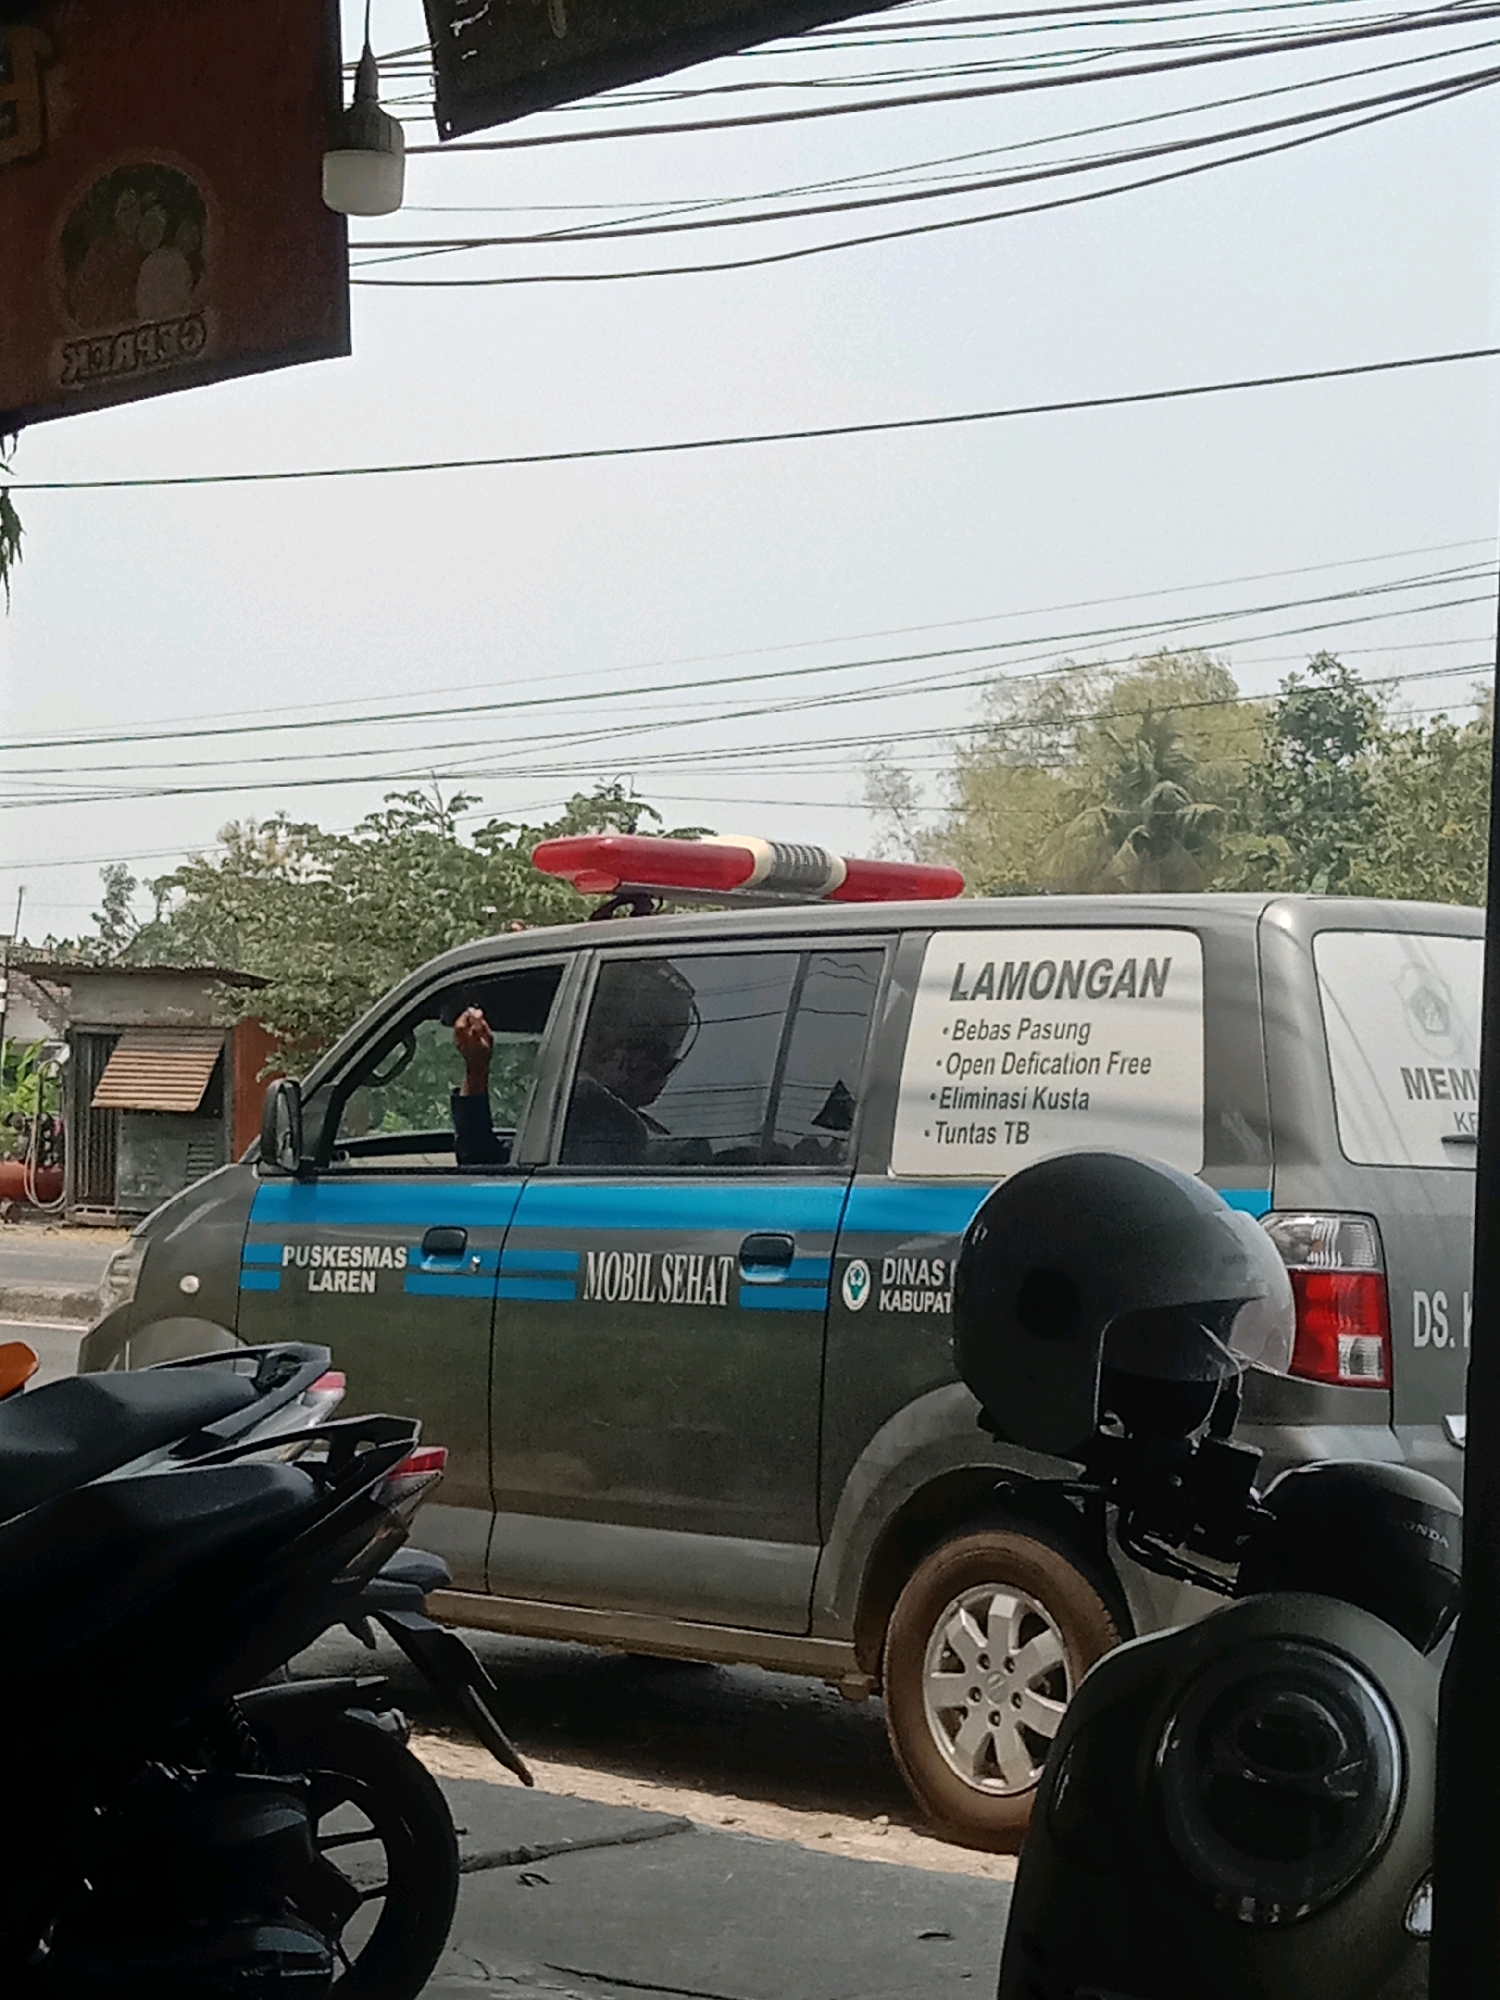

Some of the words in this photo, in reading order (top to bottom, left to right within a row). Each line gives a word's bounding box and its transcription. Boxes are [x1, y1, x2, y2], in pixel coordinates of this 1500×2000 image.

[950, 957, 1172, 1001] LAMONGAN
[952, 1018, 1011, 1041] Bebas
[1017, 1018, 1091, 1045] Pasung
[946, 1052, 995, 1080] Open
[1001, 1051, 1101, 1075] Defication
[1106, 1051, 1151, 1075] Free
[1400, 1067, 1480, 1100] MEM
[938, 1086, 1028, 1110] Eliminasi
[1032, 1086, 1090, 1111] Kusta
[935, 1121, 997, 1144] Tuntas
[1004, 1121, 1030, 1144] TB
[282, 1245, 407, 1268] PUSKESMAS
[308, 1270, 377, 1293] LAREN
[583, 1251, 656, 1302] MOBIL
[659, 1253, 735, 1306] SEHAT
[882, 1258, 945, 1286] DINAS
[1413, 1290, 1456, 1349] DS.
